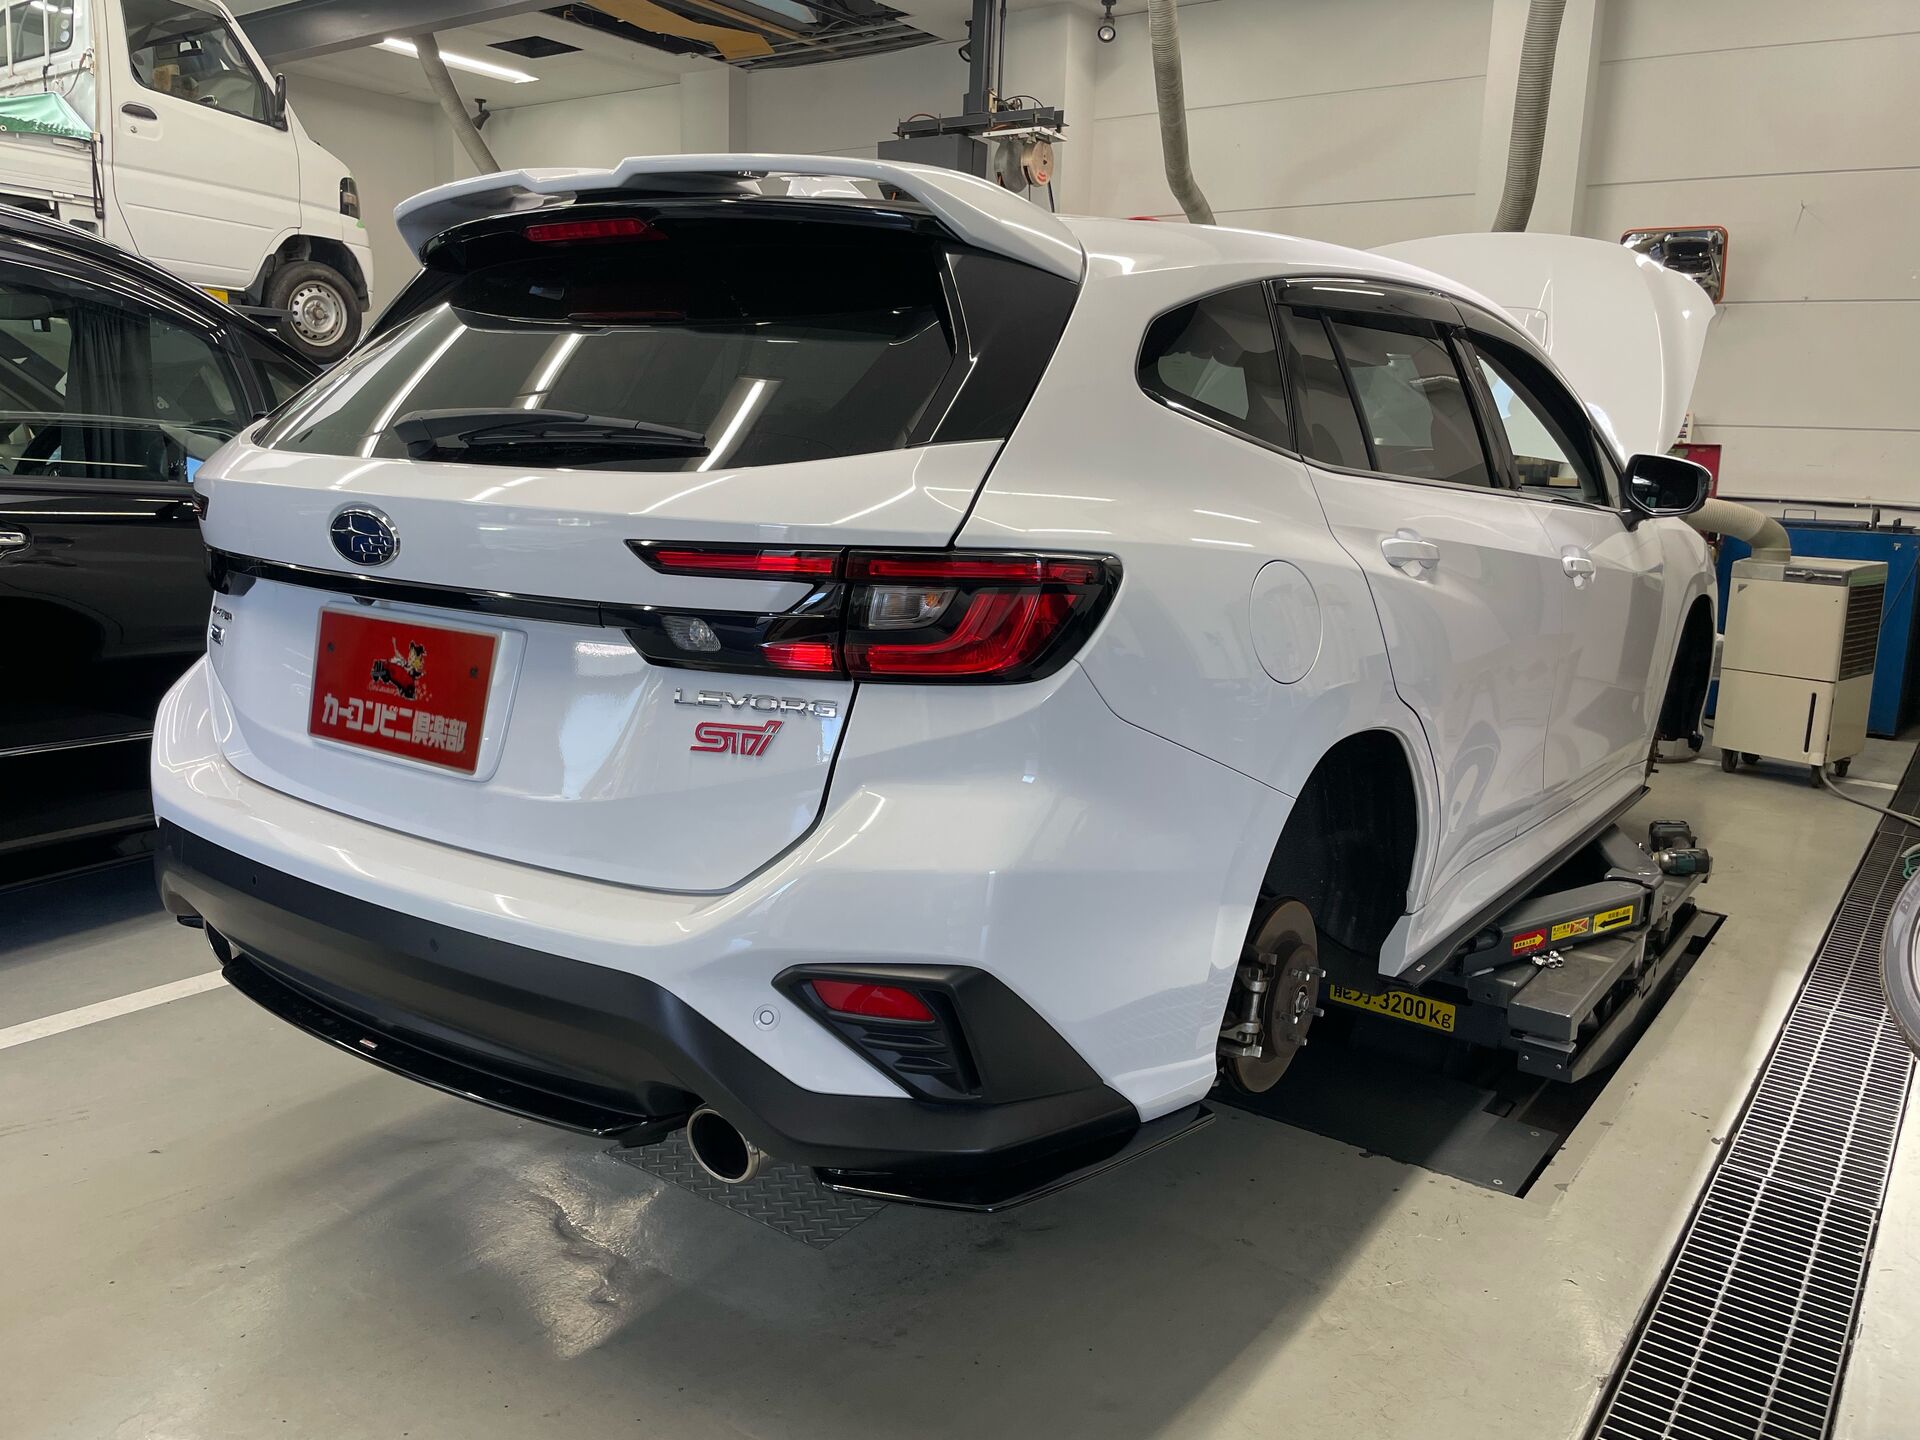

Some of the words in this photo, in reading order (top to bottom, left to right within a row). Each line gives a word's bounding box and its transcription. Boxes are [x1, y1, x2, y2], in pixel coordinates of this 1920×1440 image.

[321, 692, 468, 753] カーコンビニ倶楽部
[674, 688, 838, 719] LEVORG
